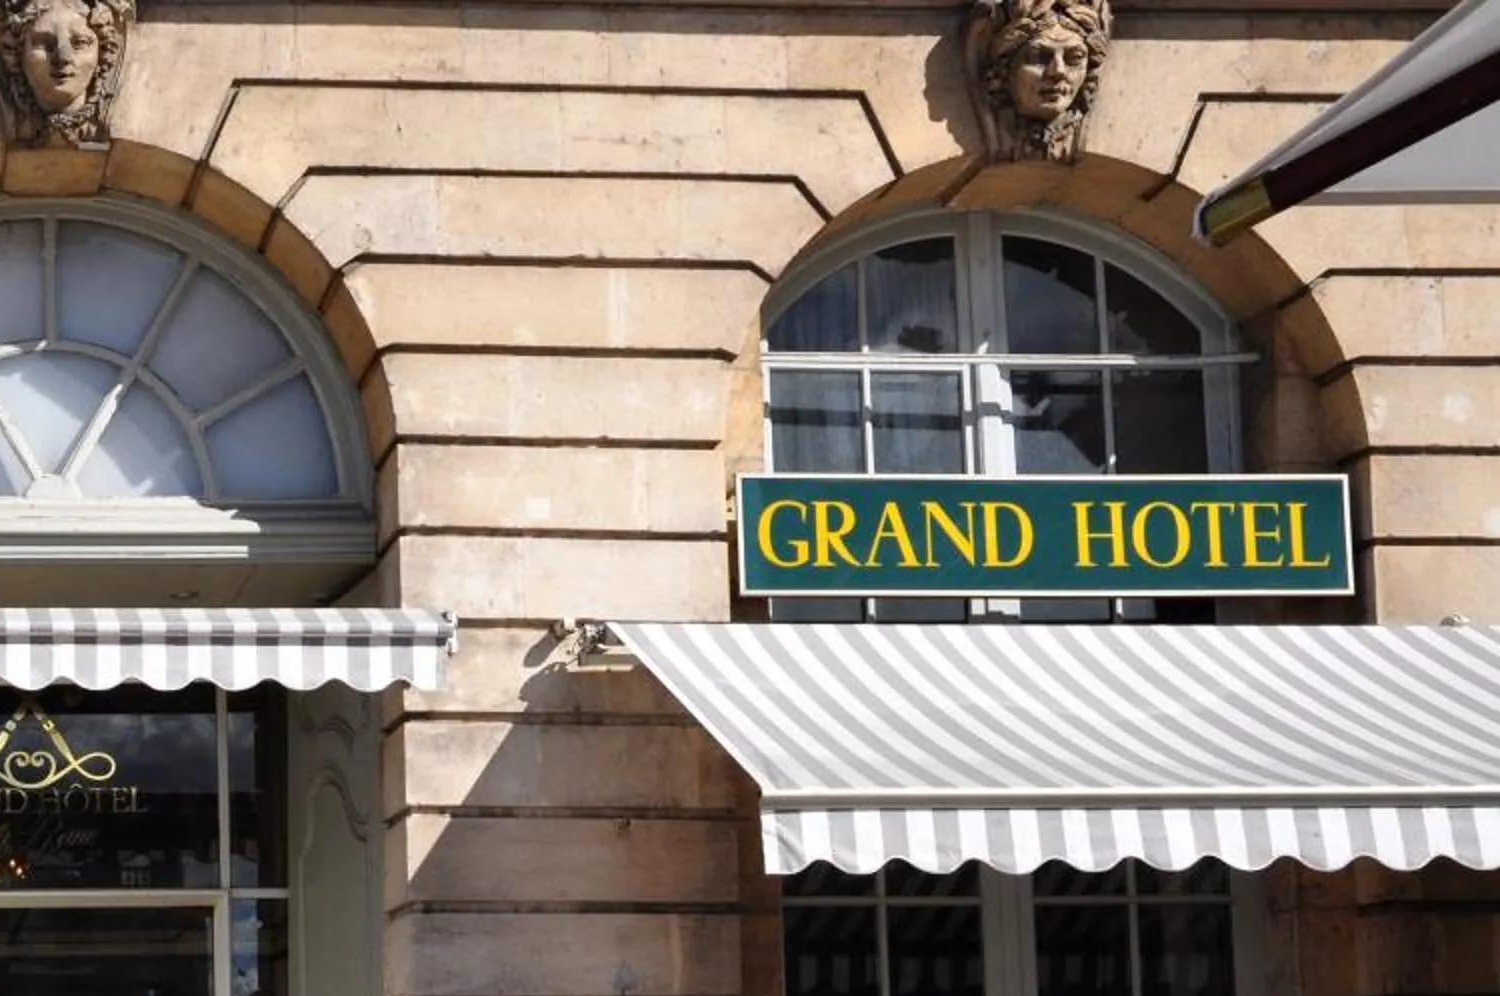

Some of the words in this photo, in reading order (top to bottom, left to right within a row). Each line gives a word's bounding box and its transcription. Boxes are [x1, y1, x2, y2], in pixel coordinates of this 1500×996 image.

[756, 499, 1034, 569] GRAND
[1072, 500, 1331, 569] HOTEL
[36, 784, 148, 814] HÔTEL
